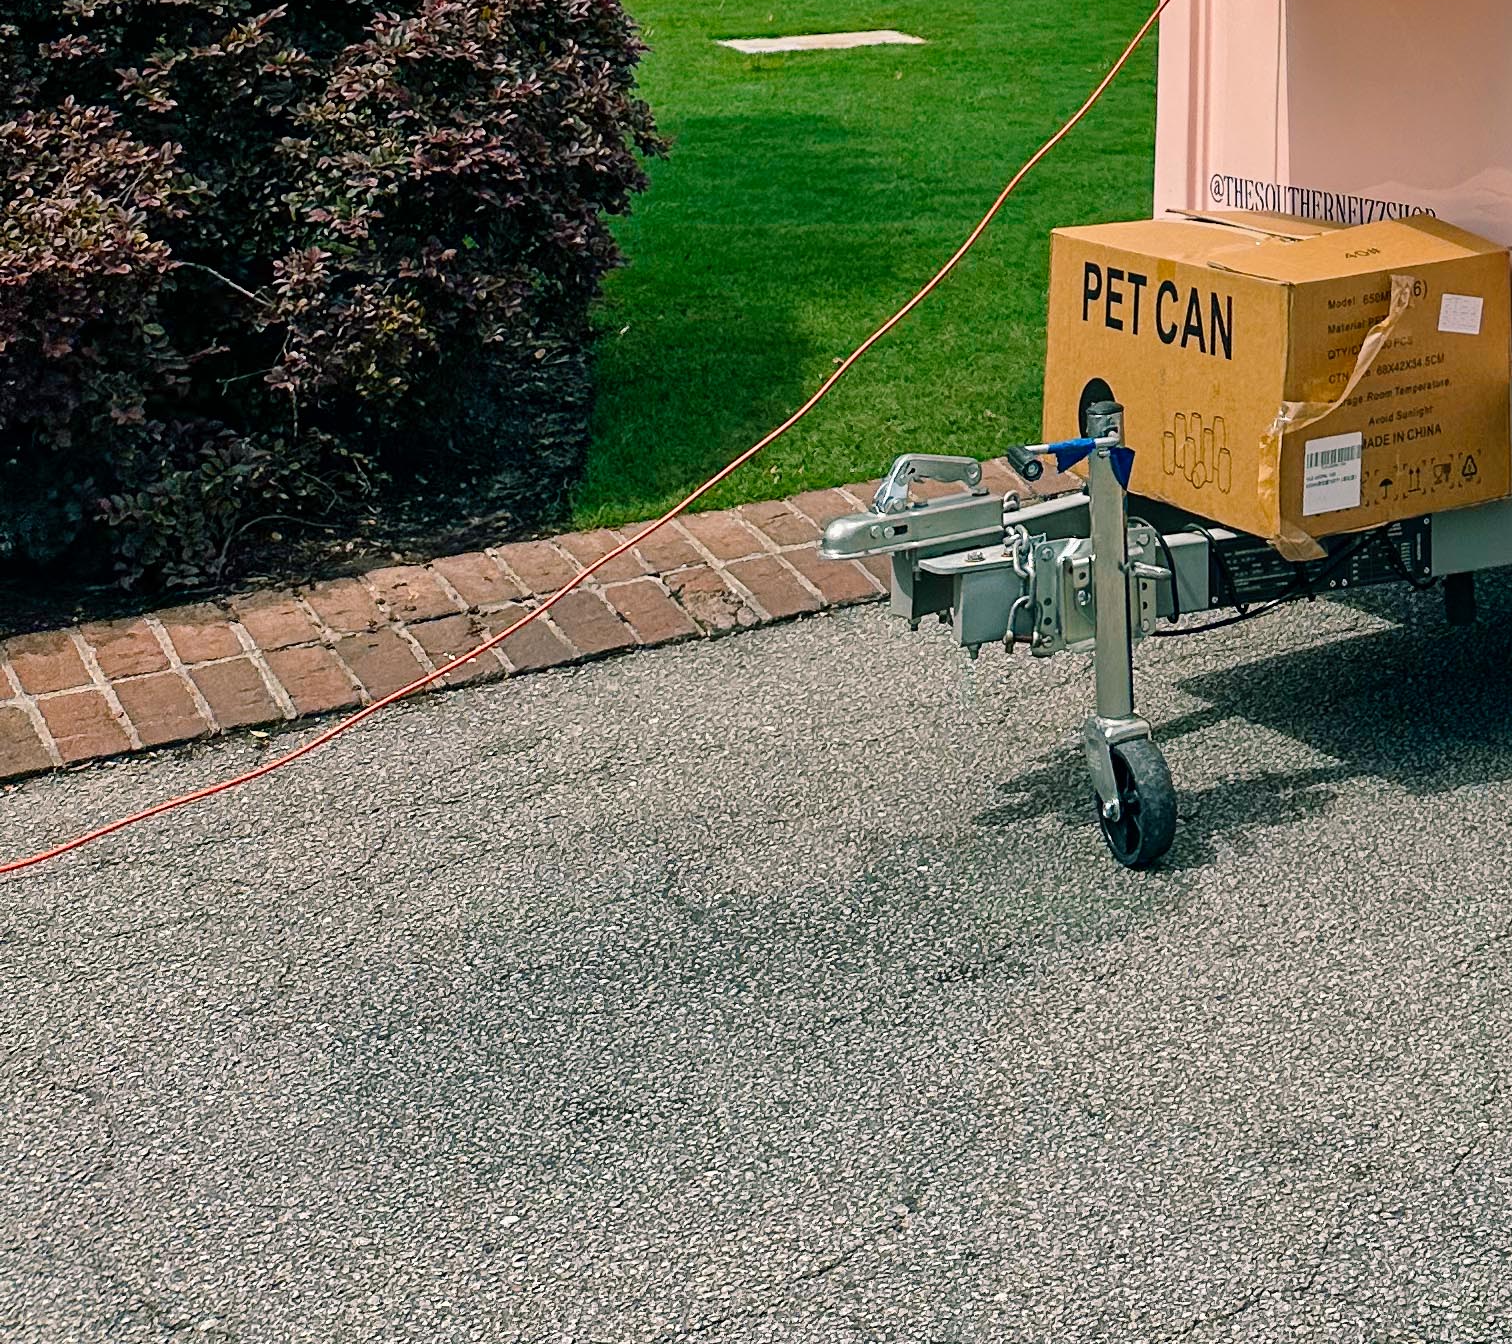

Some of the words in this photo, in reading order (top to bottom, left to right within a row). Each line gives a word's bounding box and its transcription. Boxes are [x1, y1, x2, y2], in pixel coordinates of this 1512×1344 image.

[1083, 261, 1147, 335] PET
[1156, 279, 1232, 360] CAN
[1328, 296, 1356, 309] Model
[1369, 413, 1394, 426] Avoid
[1393, 432, 1404, 445] IN
[1407, 423, 1442, 441] CHINA
